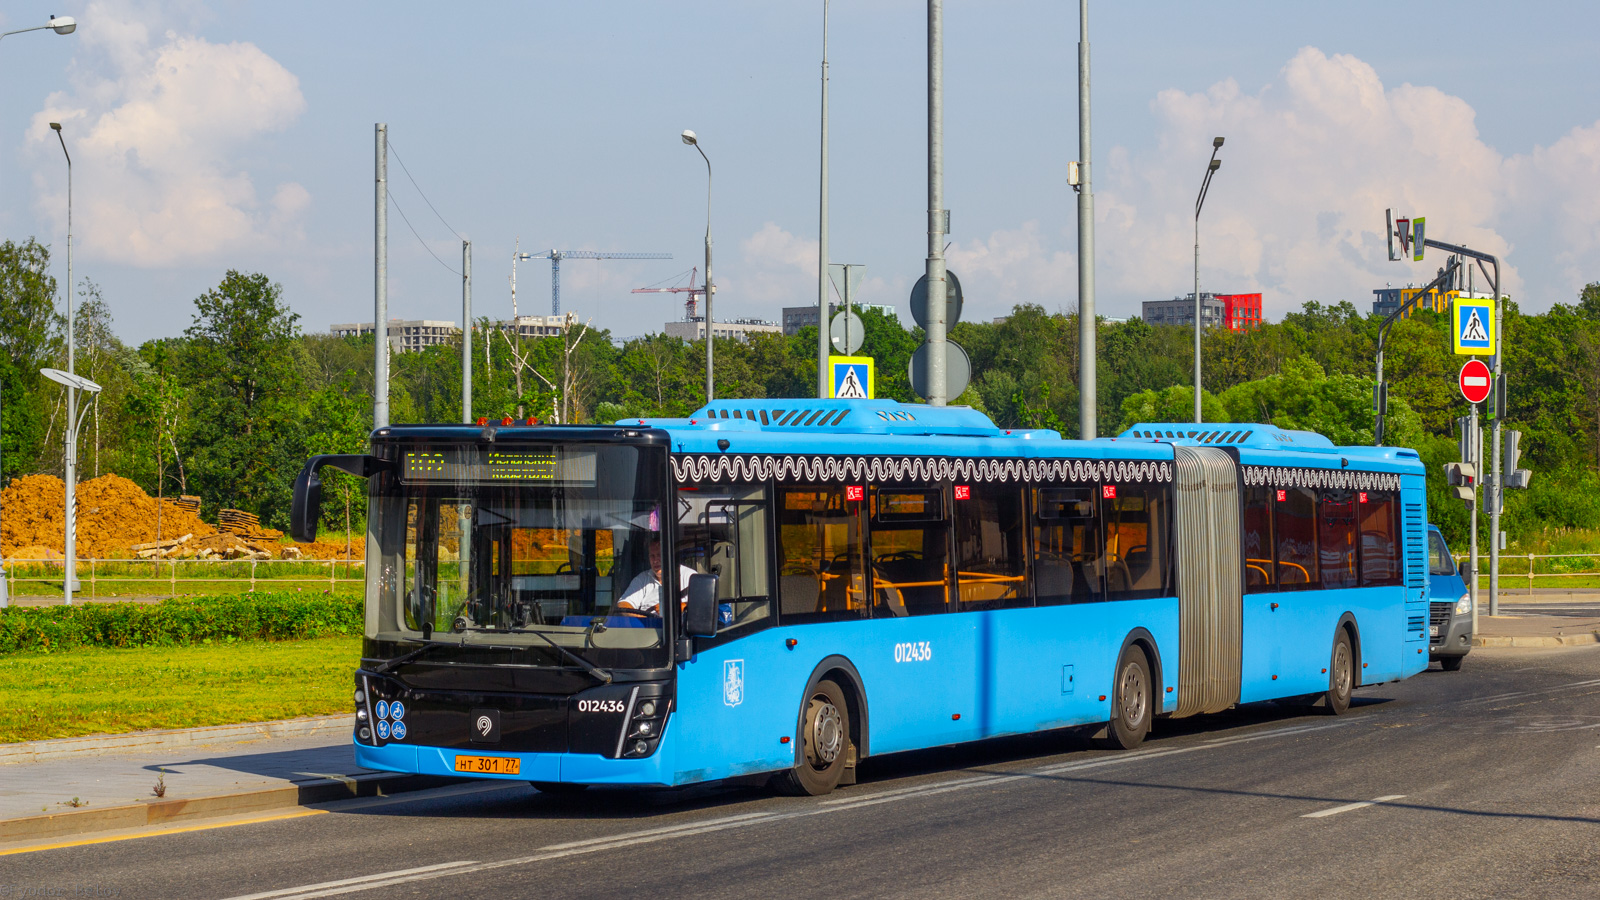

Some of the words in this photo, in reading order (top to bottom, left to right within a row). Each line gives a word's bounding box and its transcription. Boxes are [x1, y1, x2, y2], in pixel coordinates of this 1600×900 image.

[894, 641, 932, 663] 012436
[578, 699, 625, 713] 012436
[478, 758, 498, 771] 301
[505, 758, 516, 769] 77
